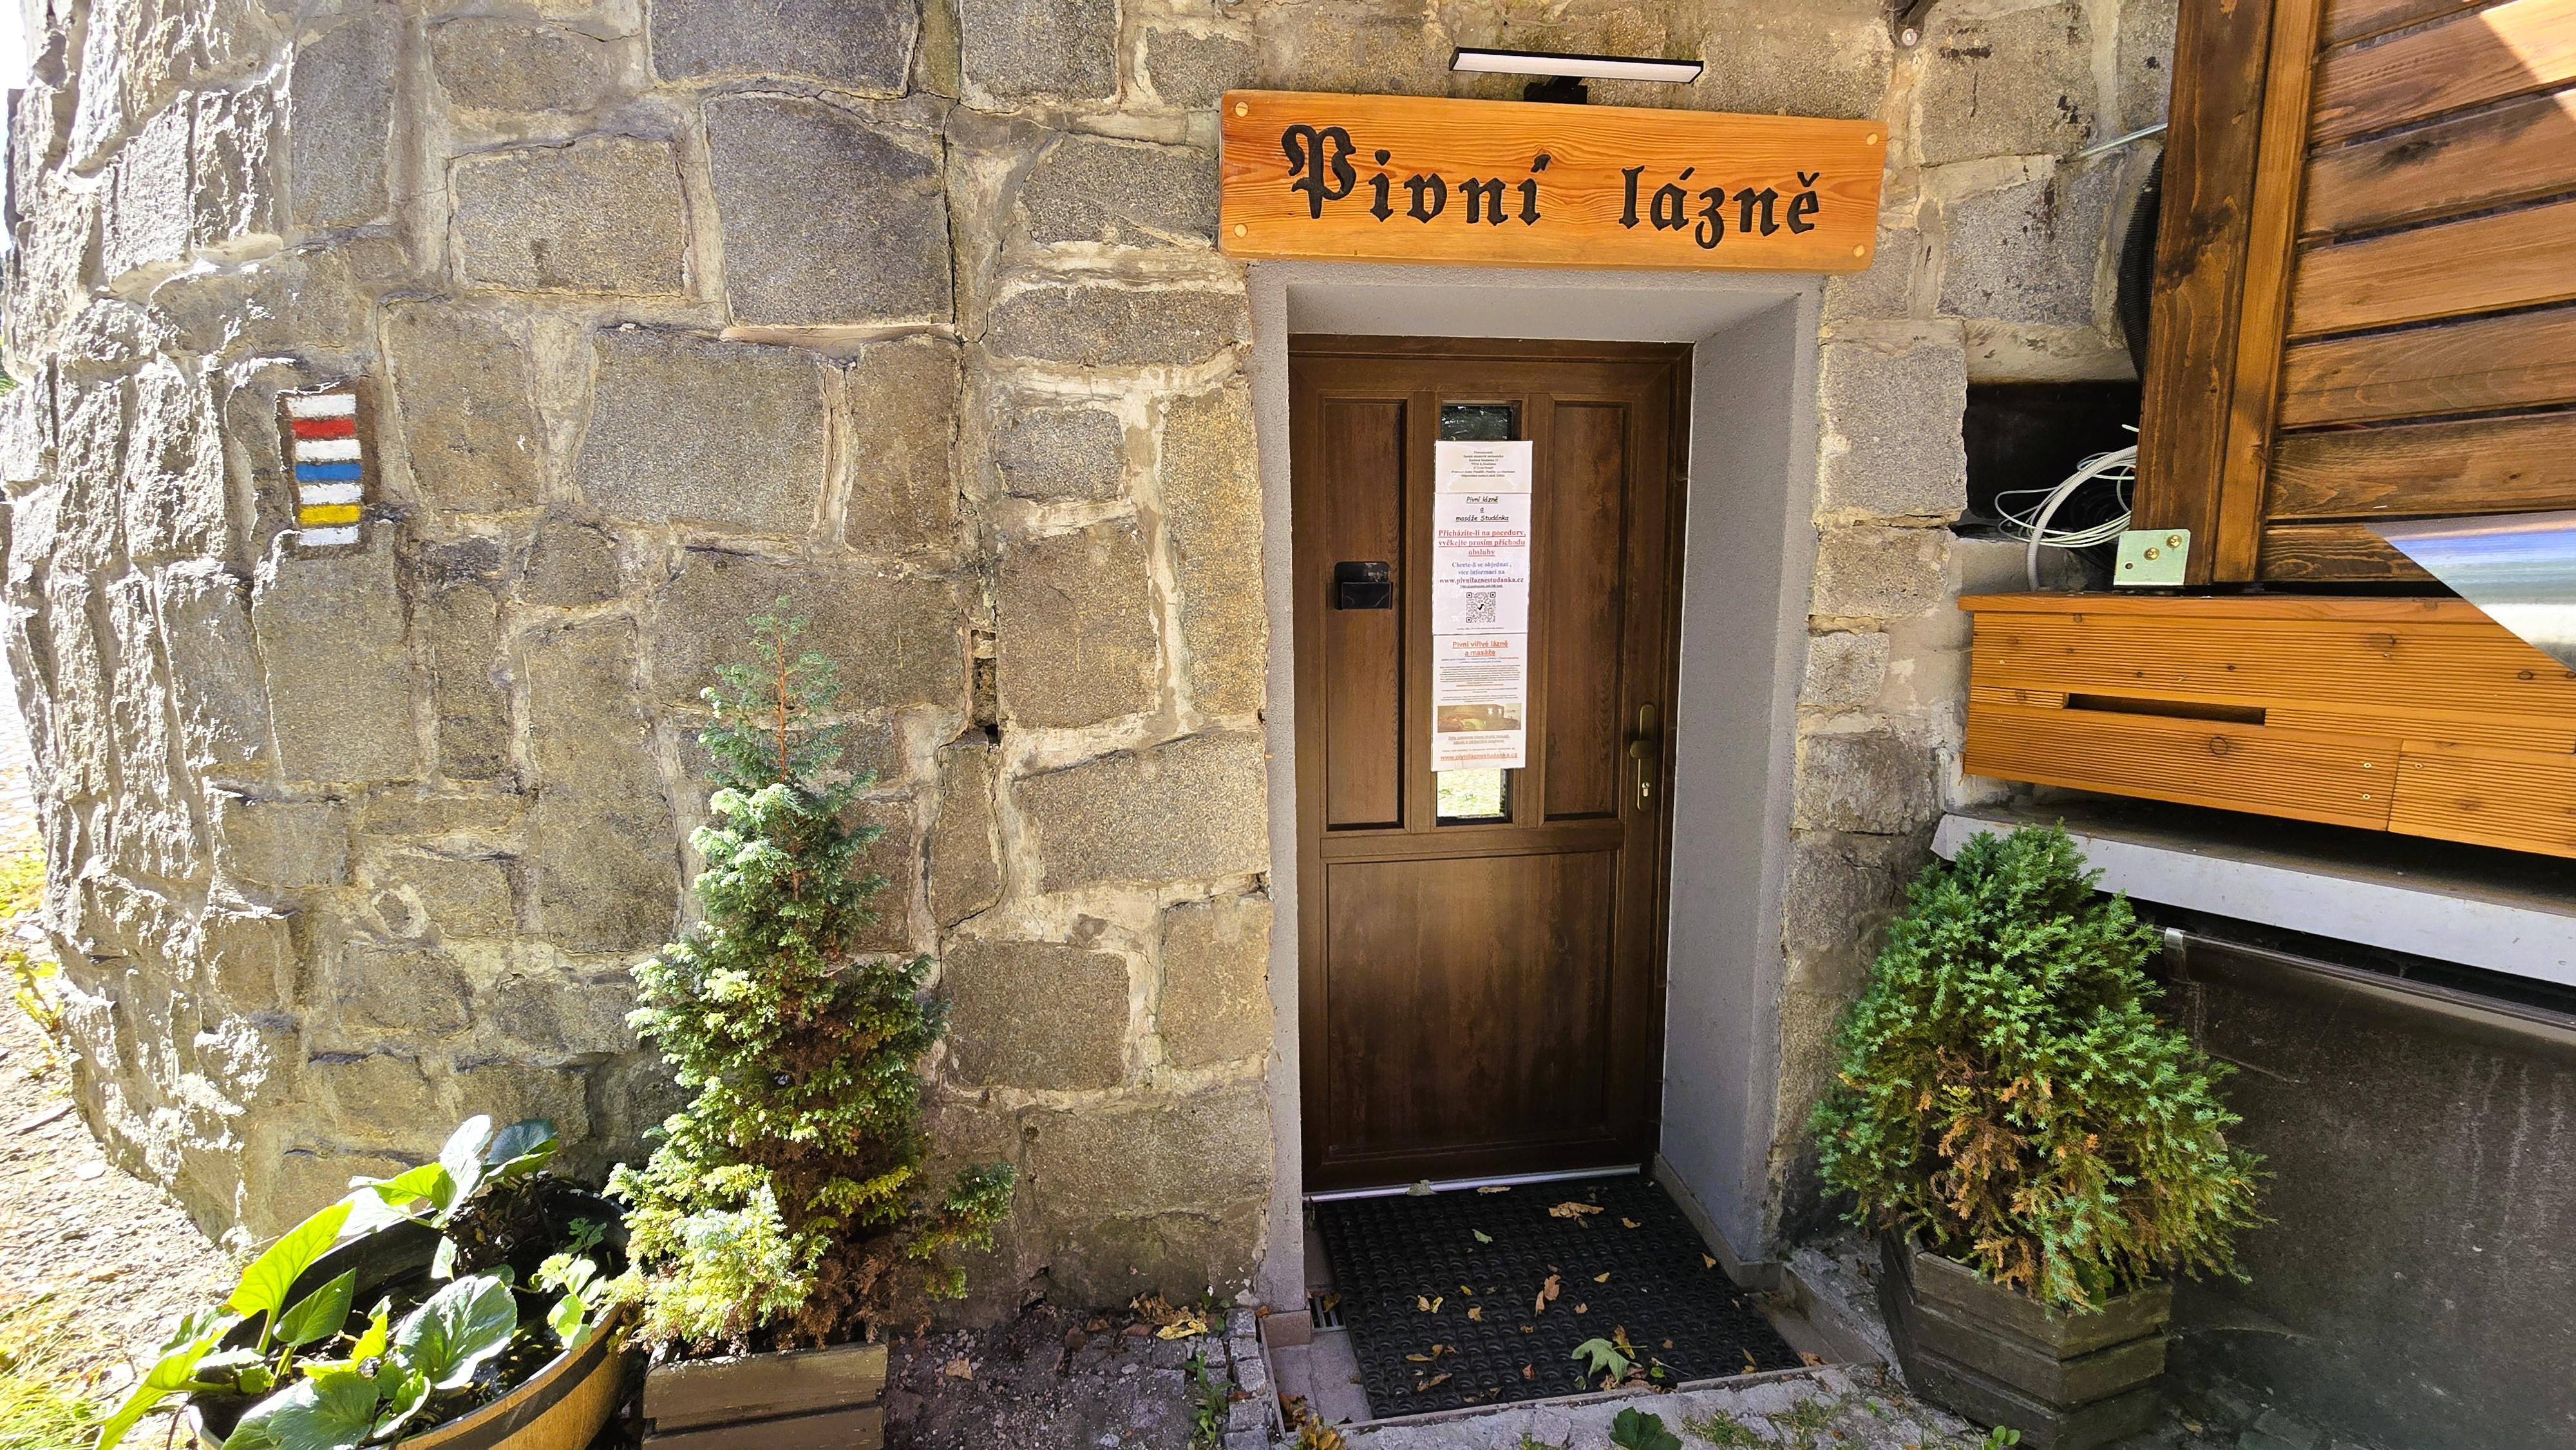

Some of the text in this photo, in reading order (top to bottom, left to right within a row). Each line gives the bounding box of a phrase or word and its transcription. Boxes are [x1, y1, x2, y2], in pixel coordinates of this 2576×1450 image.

[1281, 124, 1819, 249] Pivní lázně
[1494, 538, 1525, 547] příchodu
